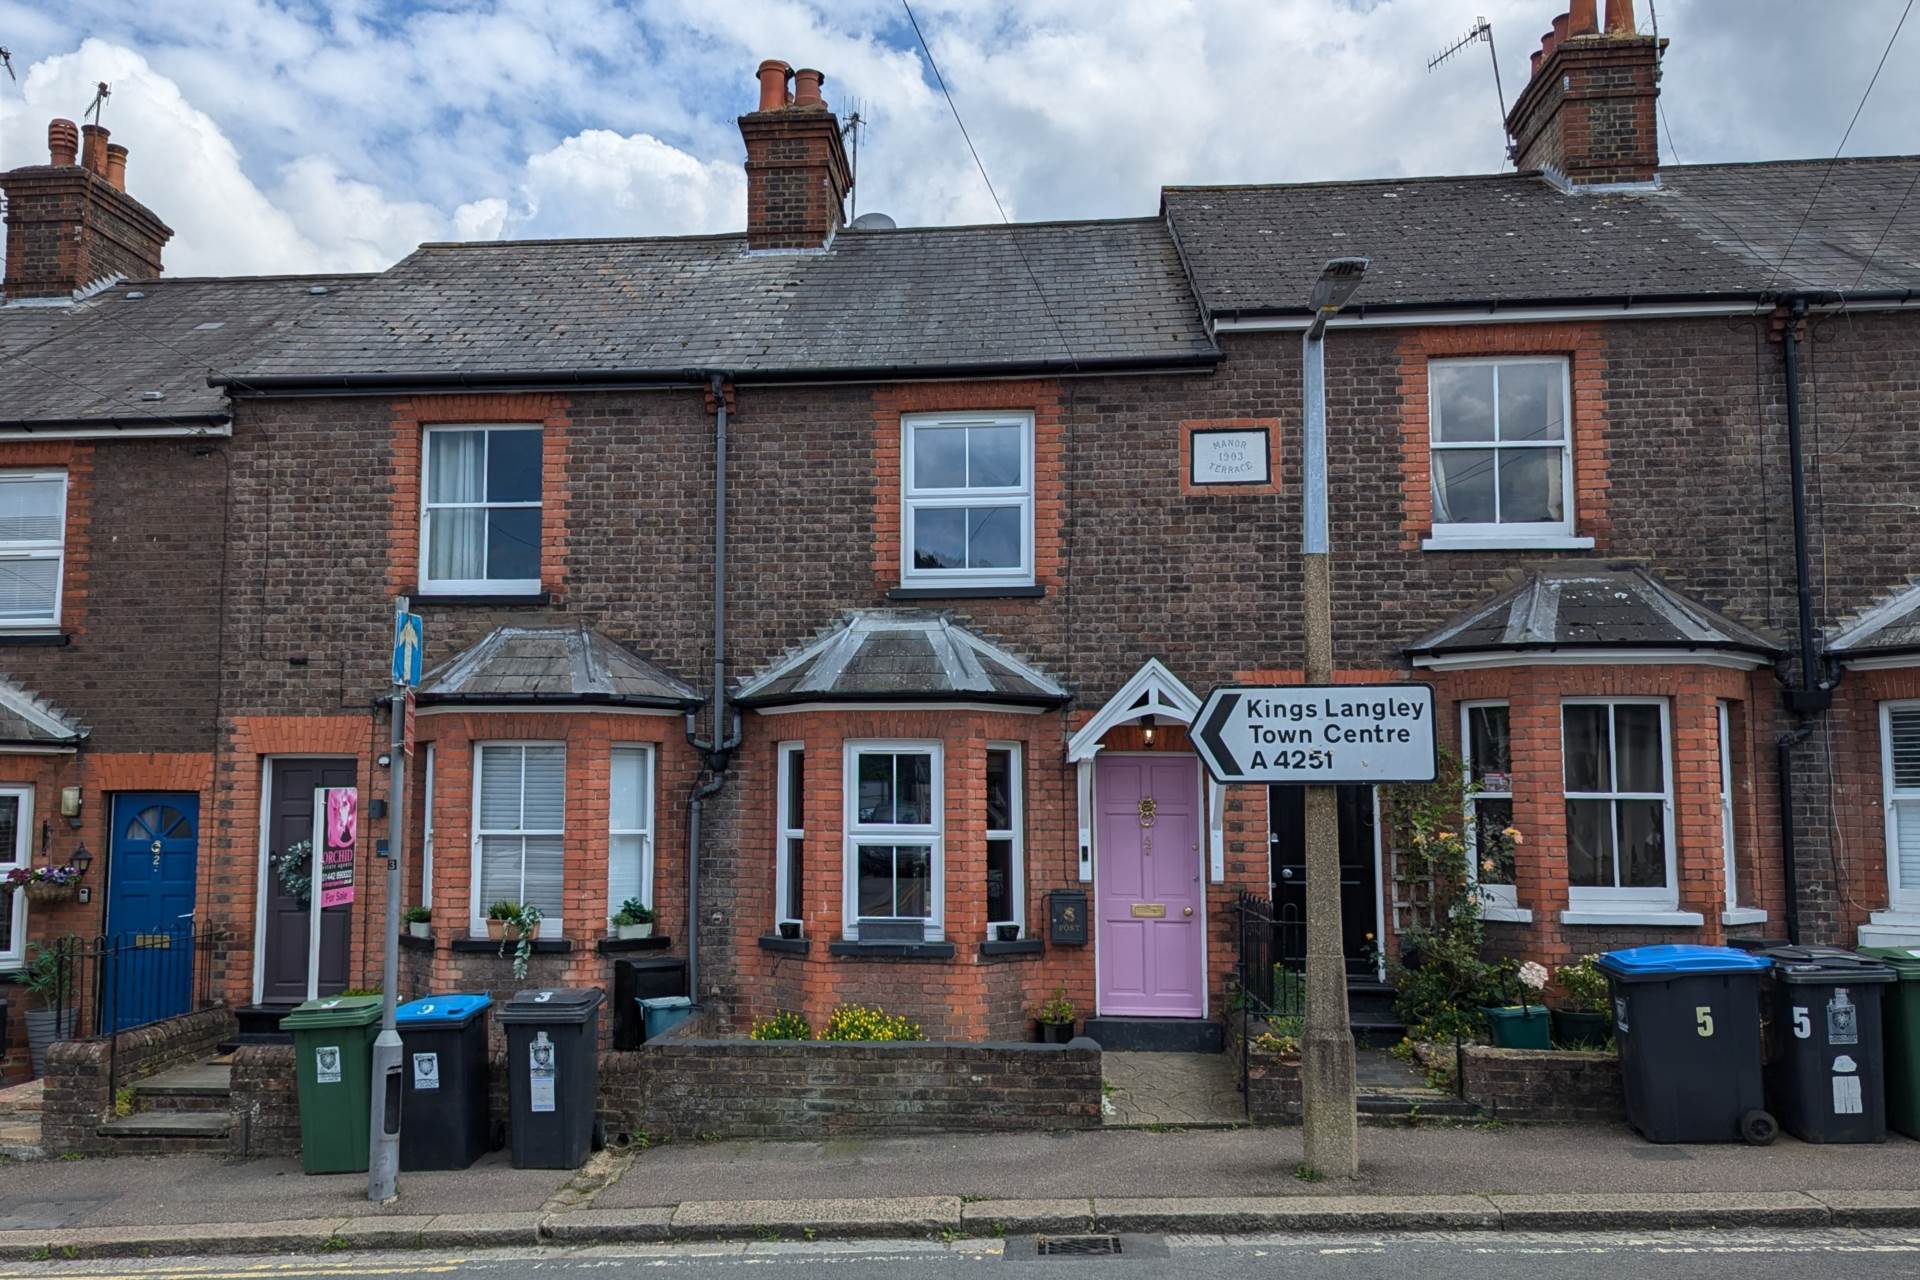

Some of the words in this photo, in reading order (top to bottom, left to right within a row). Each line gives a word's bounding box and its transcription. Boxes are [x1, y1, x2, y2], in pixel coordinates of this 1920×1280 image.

[1213, 439, 1247, 450] MANOR
[1219, 452, 1244, 461] 1903
[1208, 461, 1253, 474] TERRACE
[1247, 699, 1317, 721] Kings
[1325, 698, 1424, 721] Langley
[1249, 725, 1312, 744] Town
[1324, 724, 1410, 743] Centre
[322, 850, 353, 864] ORCHID
[325, 892, 334, 903] For
[336, 891, 347, 901] Sale
[1058, 924, 1080, 932] POST
[1695, 1006, 1714, 1037] 5
[1793, 1007, 1811, 1038] 5
